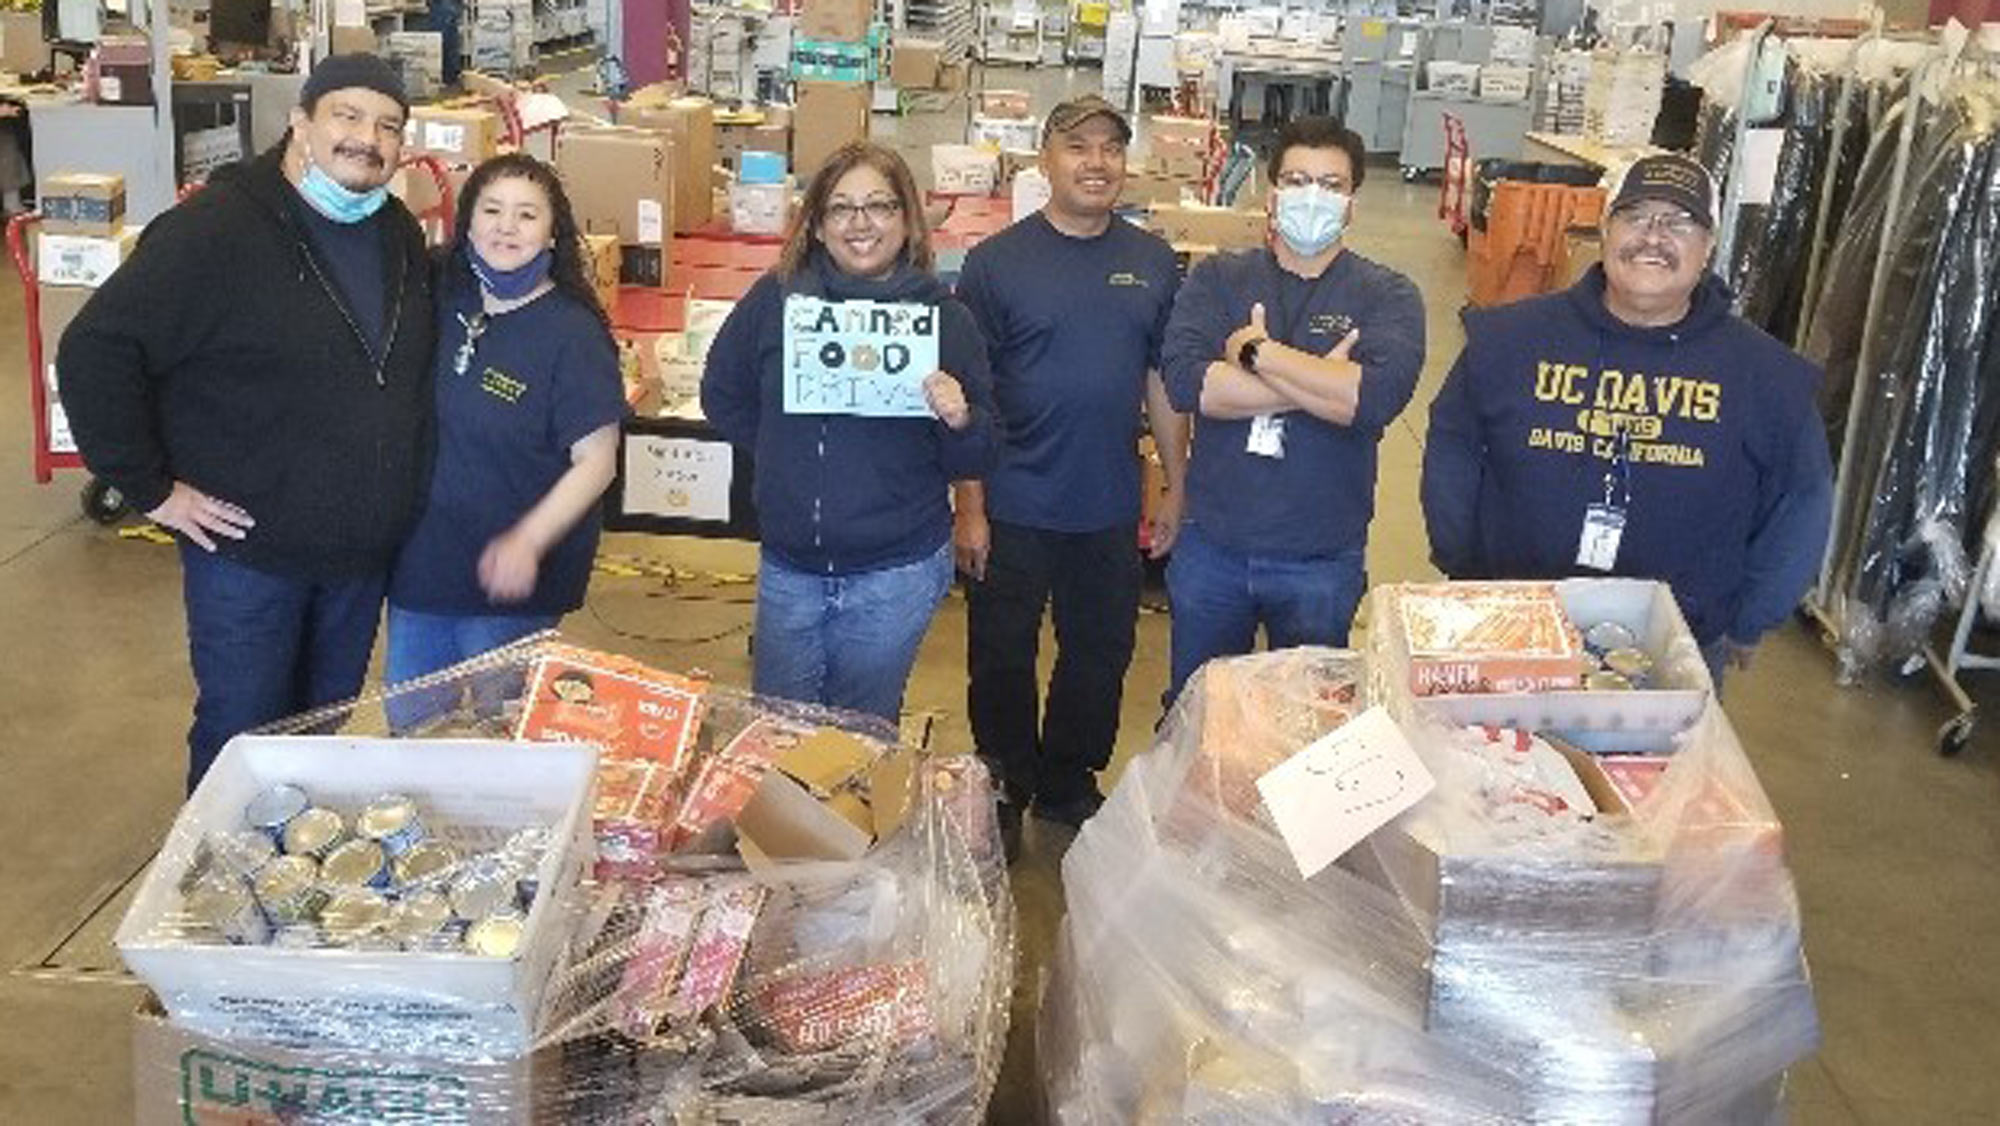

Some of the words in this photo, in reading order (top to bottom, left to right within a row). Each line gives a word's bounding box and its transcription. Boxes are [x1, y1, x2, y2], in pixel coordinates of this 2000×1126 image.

[793, 338, 911, 375] FOOD
[1534, 360, 1589, 404] UC
[1593, 369, 1721, 421] DAVIS
[1528, 428, 1585, 453] DAVIS
